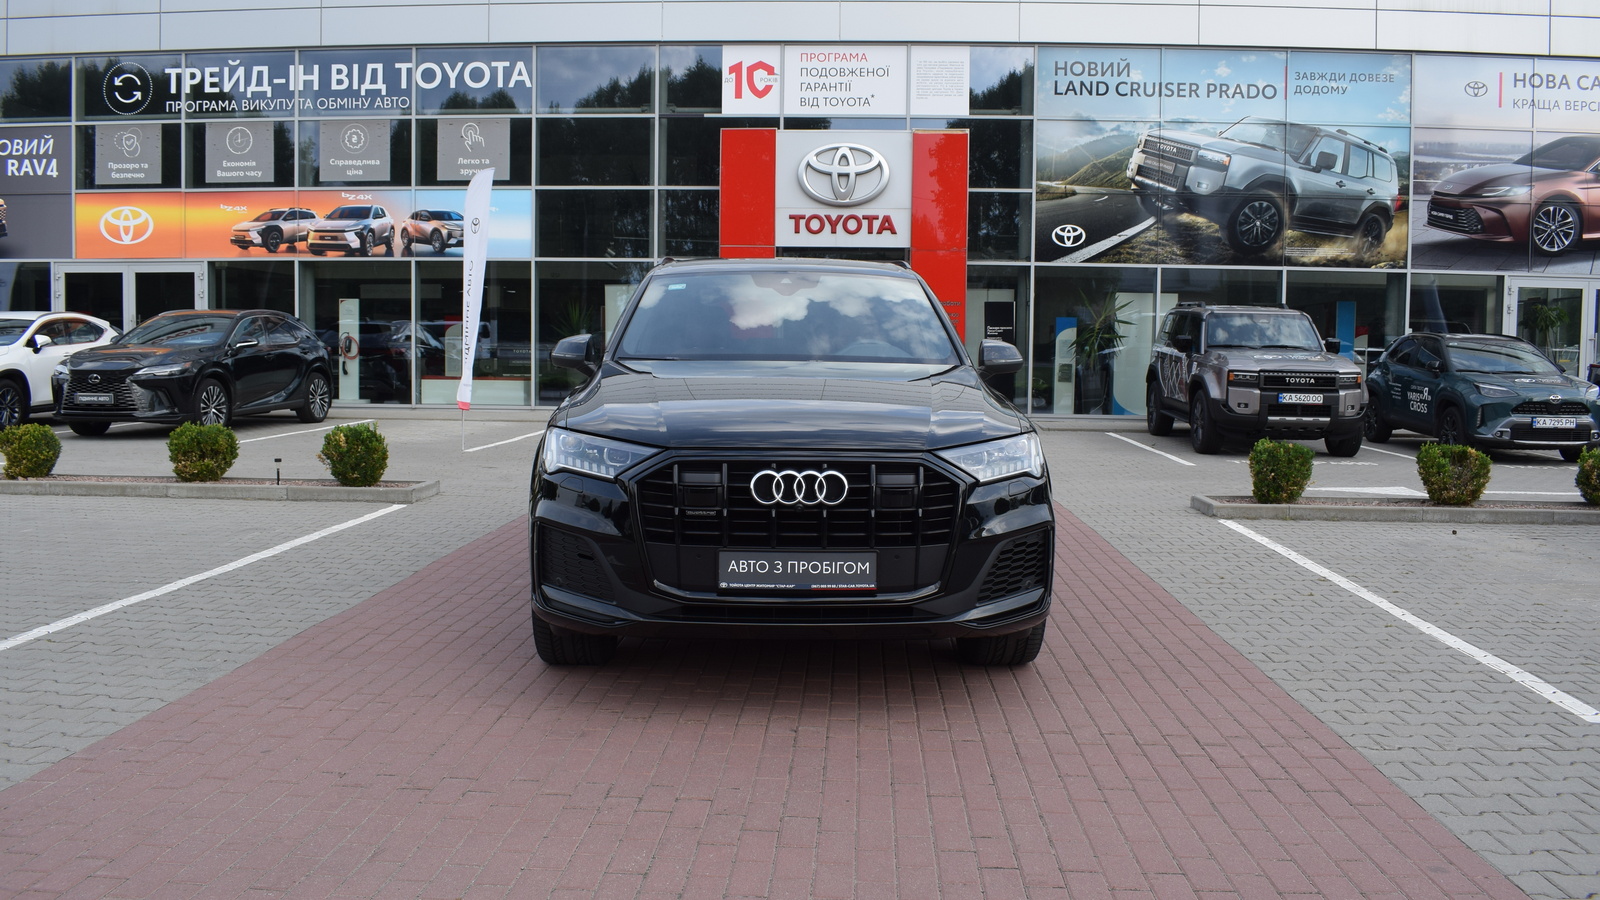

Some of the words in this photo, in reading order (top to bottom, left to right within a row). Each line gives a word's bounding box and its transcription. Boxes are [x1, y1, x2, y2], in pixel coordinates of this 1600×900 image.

[800, 52, 868, 63] ПРОГРАМА
[800, 65, 890, 79] ПОДОВЖЕНОЇ
[1054, 58, 1131, 78] НОВИЙ
[165, 60, 319, 98] ТРЕЙД-ІН
[331, 62, 386, 96] ВІД
[395, 61, 532, 90] TOYOTA
[728, 60, 775, 99] 10
[1294, 71, 1346, 83] ЗАВЖДИ
[1349, 73, 1395, 85] ДОВЕЗЕ
[1513, 72, 1571, 90] НОВА
[800, 79, 852, 93] ГАРАНТІЇ
[1053, 79, 1109, 97] LAND
[1115, 81, 1200, 99] CRUISER
[1206, 83, 1278, 100] PRADO
[1294, 84, 1348, 97] ДОДОМУ
[165, 100, 238, 113] ПРОГРАМА
[242, 98, 295, 111] ВИКУПУ
[297, 98, 313, 110] ТА
[317, 96, 371, 110] ОБМІНУ
[374, 96, 410, 110] АВТО
[800, 96, 820, 109] ВІД
[1512, 98, 1561, 112] КРАЩА
[1156, 143, 1177, 153] TOYOTA
[108, 161, 139, 171] Прозоро
[222, 159, 256, 168] Економія
[330, 157, 380, 168] Справедлива
[457, 157, 480, 165] Легко
[7, 158, 59, 178] RAV4
[111, 170, 145, 179] безпечно
[216, 169, 245, 178] Вашого
[245, 170, 262, 179] часу
[346, 168, 363, 177] ціна
[788, 213, 897, 235] TOYOTA
[1282, 394, 1293, 402] KA
[1407, 391, 1420, 401] YARIS
[1409, 401, 1428, 414] CROSS
[1536, 418, 1547, 426] KA
[1548, 418, 1564, 426] 7295
[1564, 418, 1575, 426] PH
[727, 560, 769, 574] АВТО
[773, 560, 783, 574] З
[787, 560, 870, 575] ПРОБІГОМ
